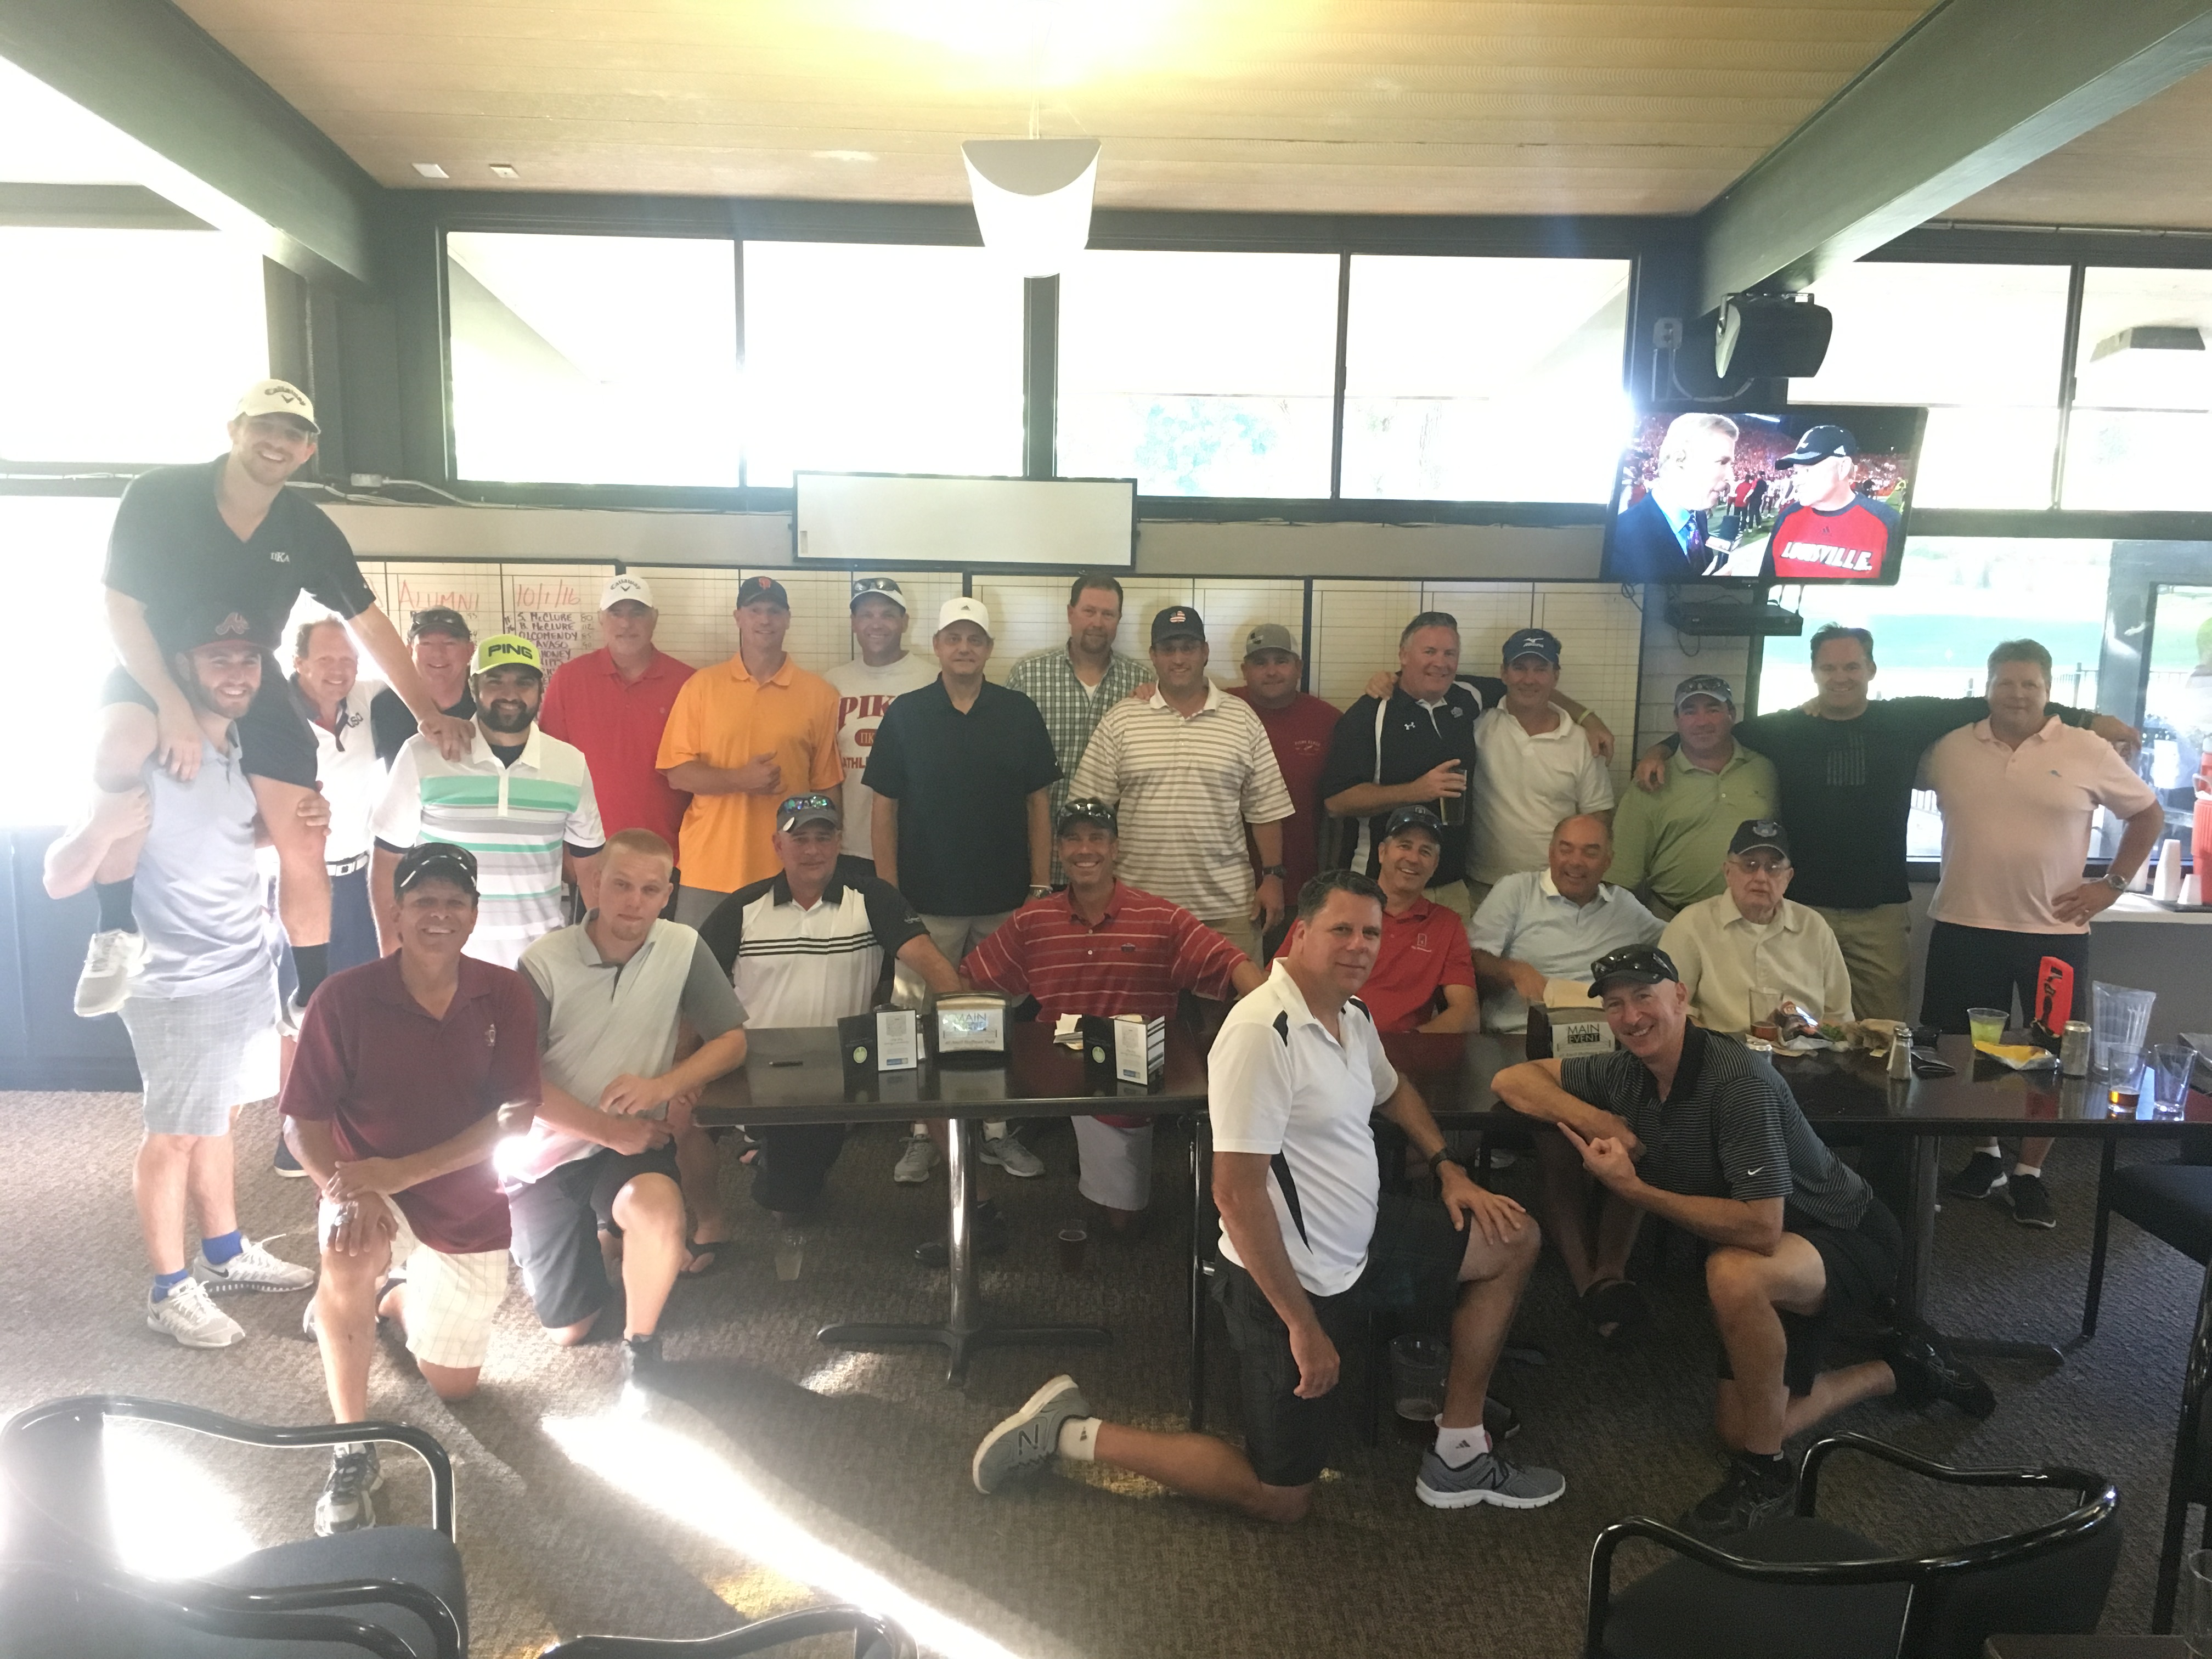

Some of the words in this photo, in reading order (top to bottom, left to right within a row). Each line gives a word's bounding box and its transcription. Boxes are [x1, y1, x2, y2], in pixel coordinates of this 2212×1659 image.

[610, 579, 641, 590] Callaway
[399, 580, 479, 611] ALUMNI
[517, 579, 580, 610] 10/1/16
[531, 613, 572, 622] McCLURE
[532, 622, 575, 631] McCLURE
[535, 640, 568, 648] AVASO
[488, 644, 533, 659] PING
[838, 695, 895, 735] PIK
[842, 757, 866, 769] ATHL
[1568, 1023, 1599, 1035] MAIN
[1568, 1034, 1600, 1043] EVENT
